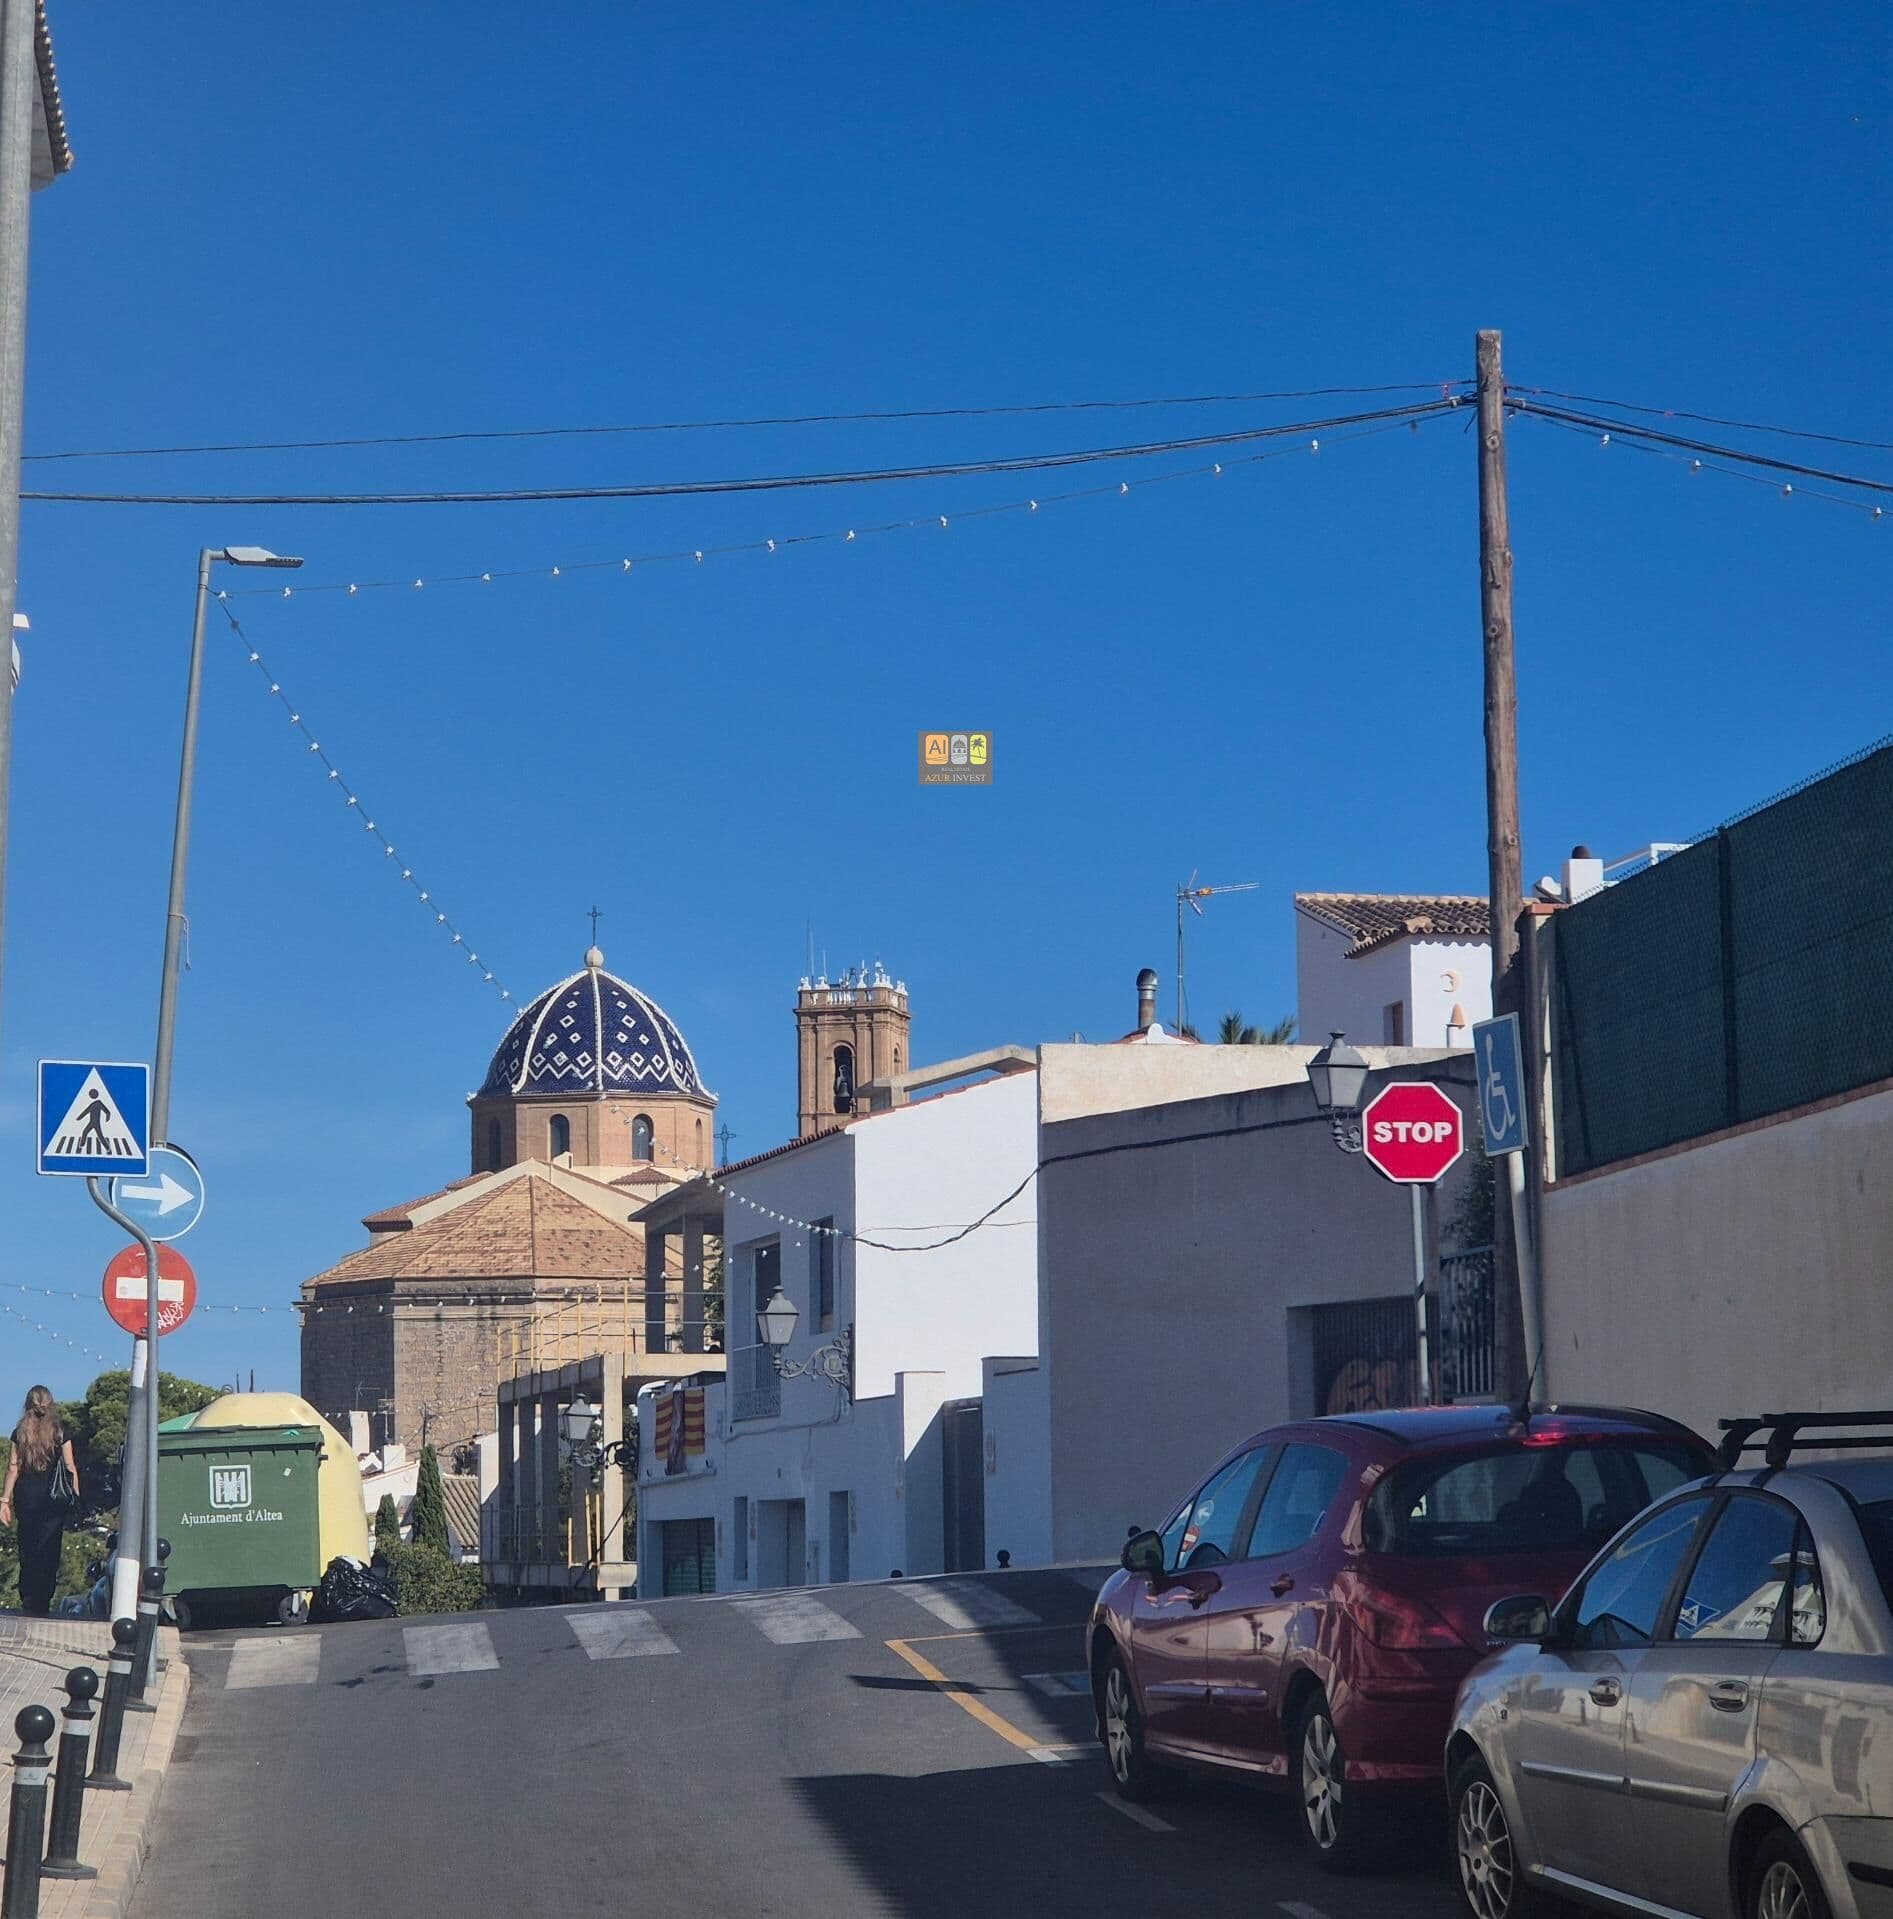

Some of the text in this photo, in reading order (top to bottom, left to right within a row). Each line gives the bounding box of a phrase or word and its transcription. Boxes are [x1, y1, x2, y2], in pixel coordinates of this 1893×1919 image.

[1373, 1121, 1453, 1143] STOP
[180, 1509, 283, 1528] Ajuntament d'Altea
